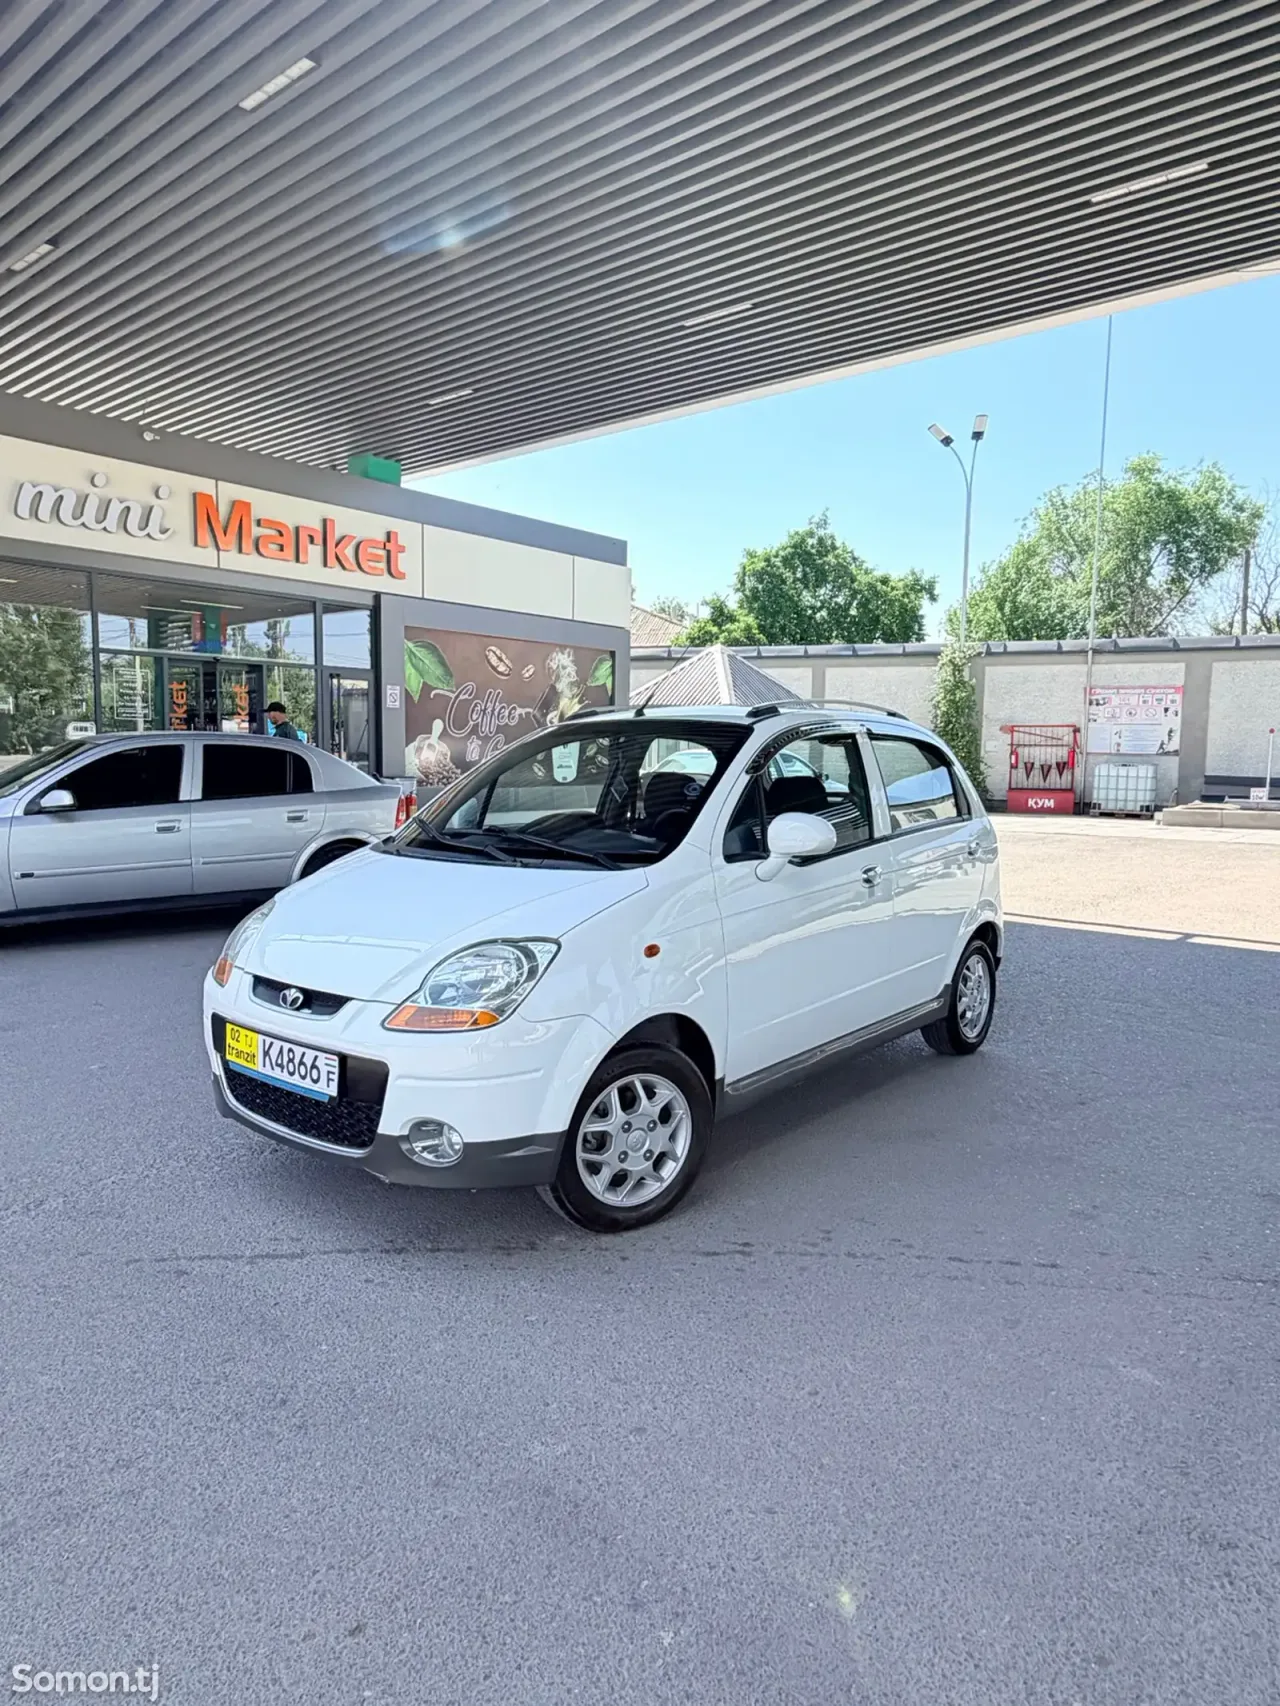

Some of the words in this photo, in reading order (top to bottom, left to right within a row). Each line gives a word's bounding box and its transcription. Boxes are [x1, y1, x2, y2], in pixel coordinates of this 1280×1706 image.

[14, 473, 174, 540] mini
[192, 491, 406, 580] Market
[168, 681, 188, 730] rket
[232, 683, 249, 732] rket
[431, 681, 532, 737] Coffee
[466, 735, 482, 761] to
[227, 1042, 256, 1066] tranzit
[230, 1027, 241, 1043] 02
[244, 1033, 253, 1048] TJ
[262, 1038, 321, 1085] K4866
[326, 1070, 336, 1088] F
